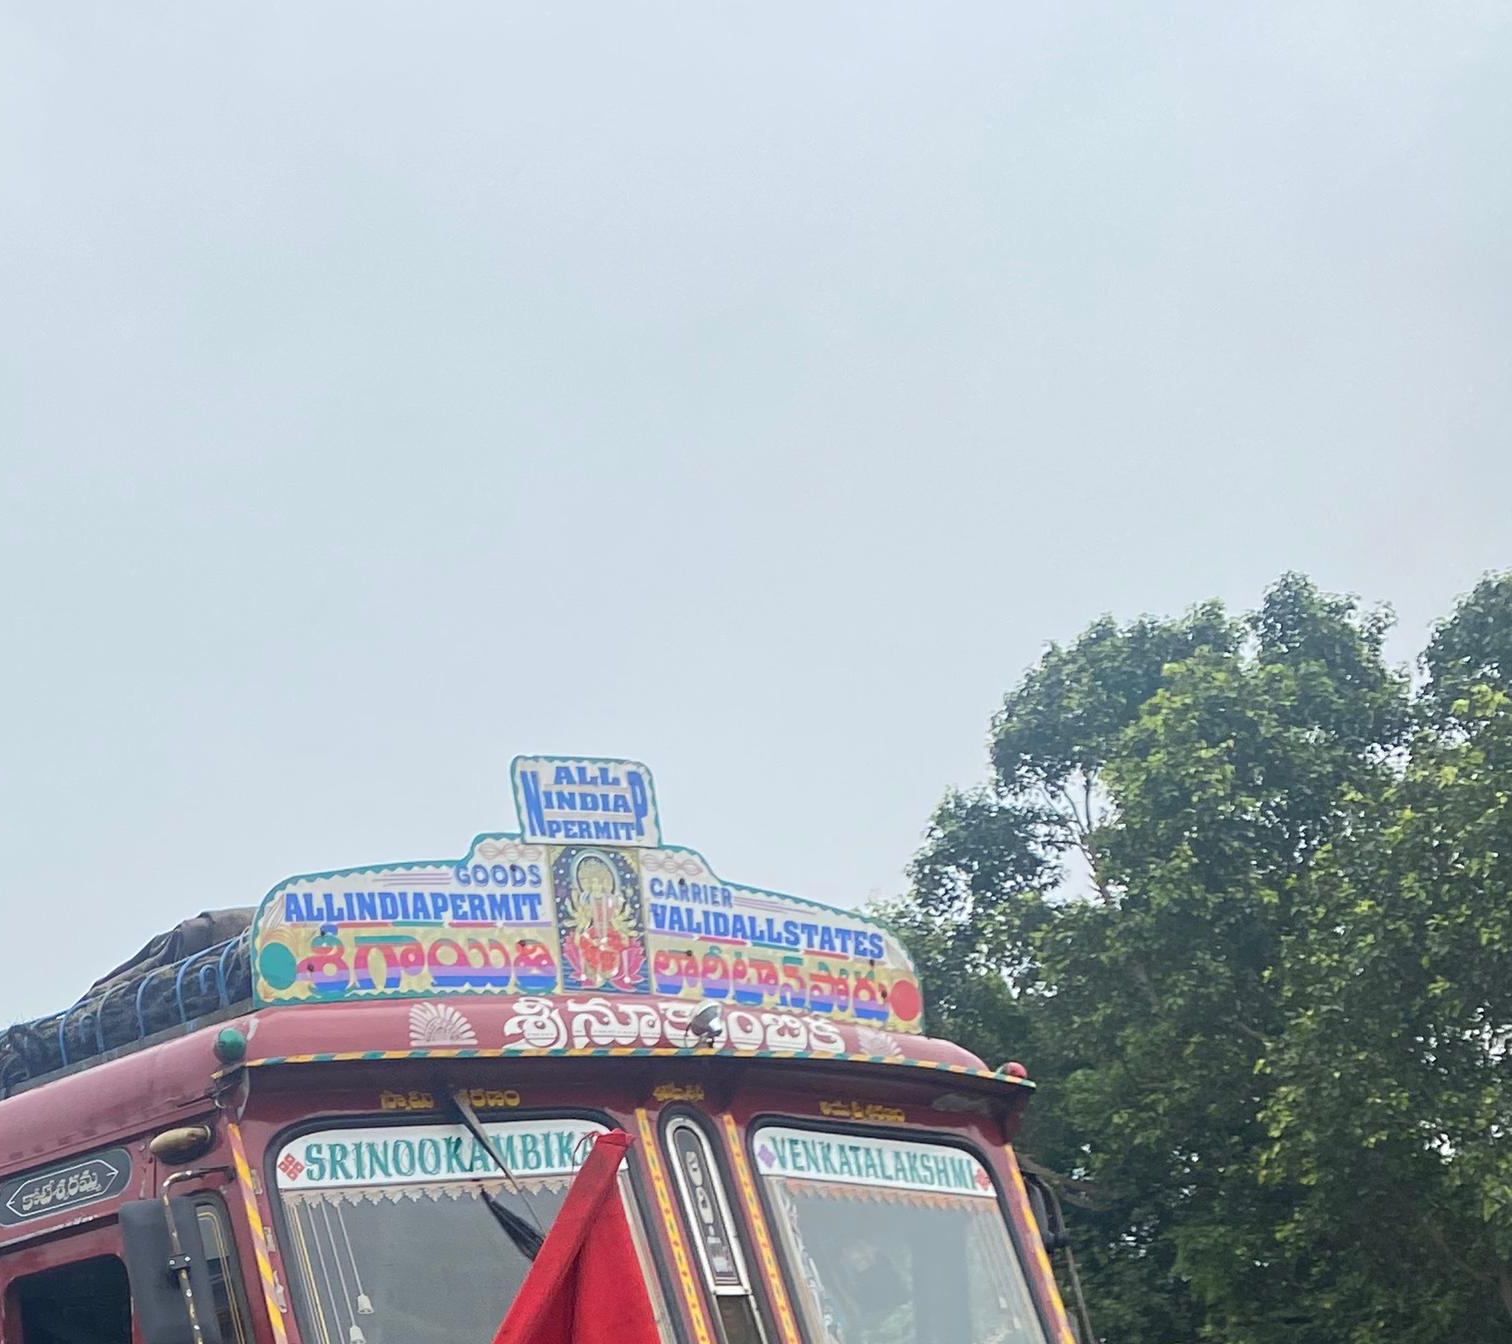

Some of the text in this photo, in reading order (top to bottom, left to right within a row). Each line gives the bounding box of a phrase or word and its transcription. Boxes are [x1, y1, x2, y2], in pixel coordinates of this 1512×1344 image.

[554, 766, 620, 786] ALL
[520, 770, 546, 836] N
[543, 790, 632, 813] INDIA
[627, 771, 648, 836] P
[547, 820, 635, 840] PERMIT
[455, 864, 542, 888] GOODS
[649, 878, 733, 908] CARRIER
[769, 1136, 978, 1191] VENKATALAKSHMI
